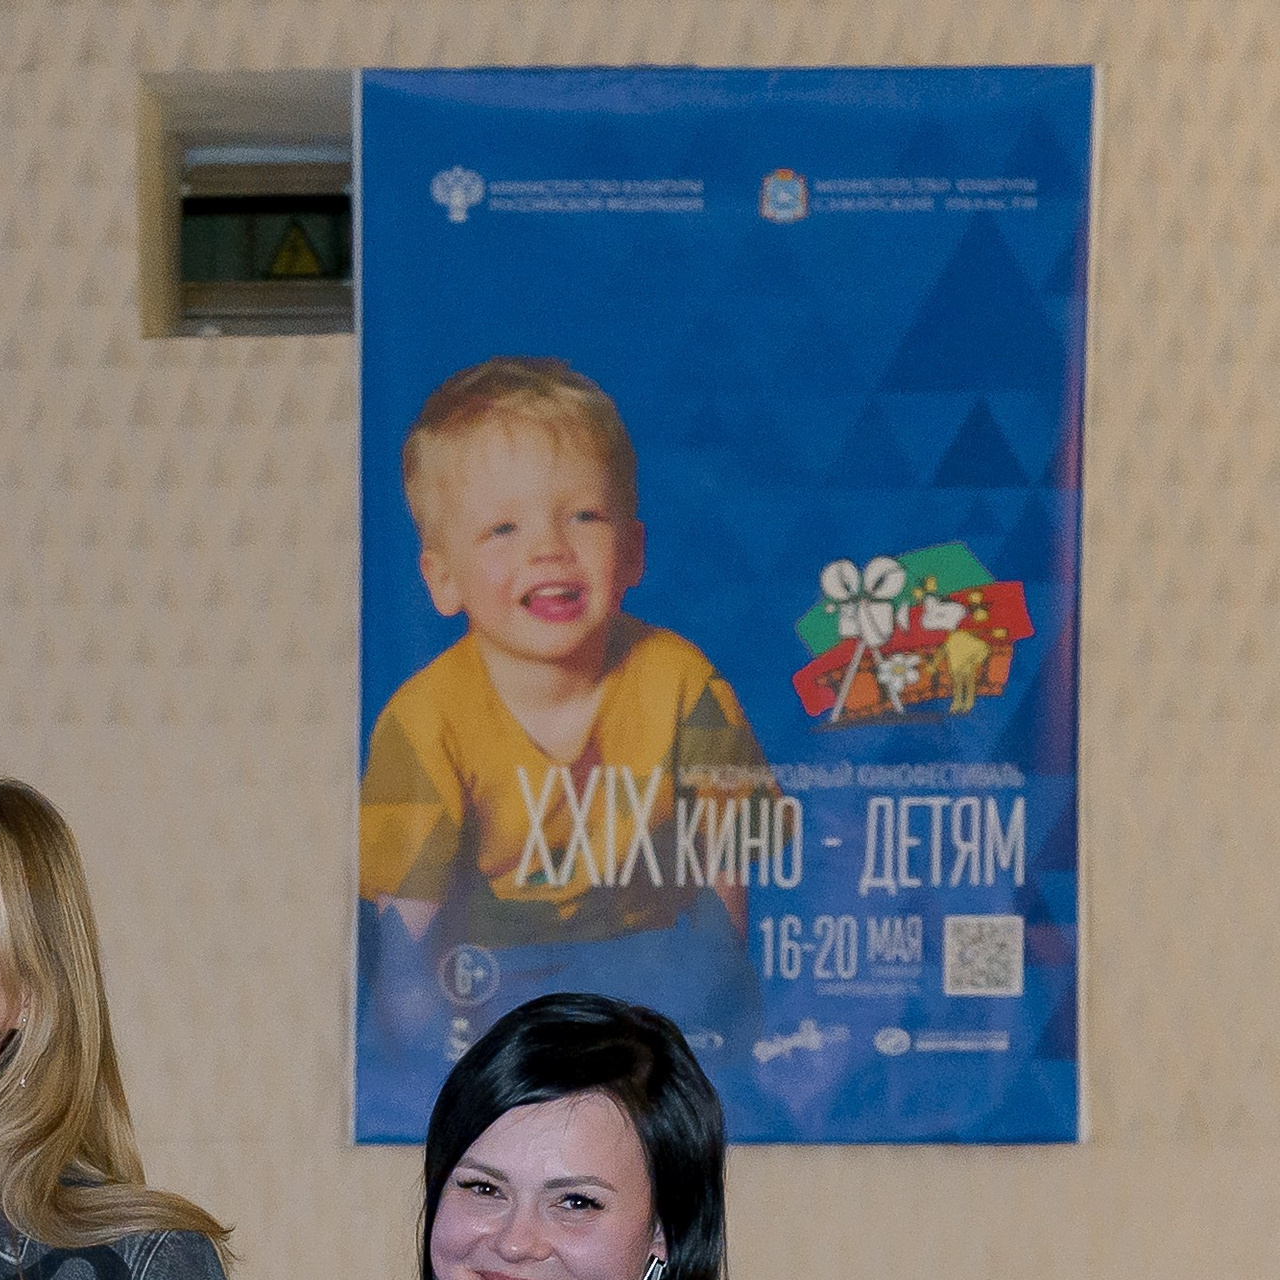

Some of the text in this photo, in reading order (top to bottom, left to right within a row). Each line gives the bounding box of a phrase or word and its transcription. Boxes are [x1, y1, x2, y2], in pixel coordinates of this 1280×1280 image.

[515, 765, 664, 888] XXIX
[675, 796, 804, 889] КИНО
[857, 796, 1026, 897] ДЕТЯМ
[759, 914, 923, 981] 16-20 МАЯ
